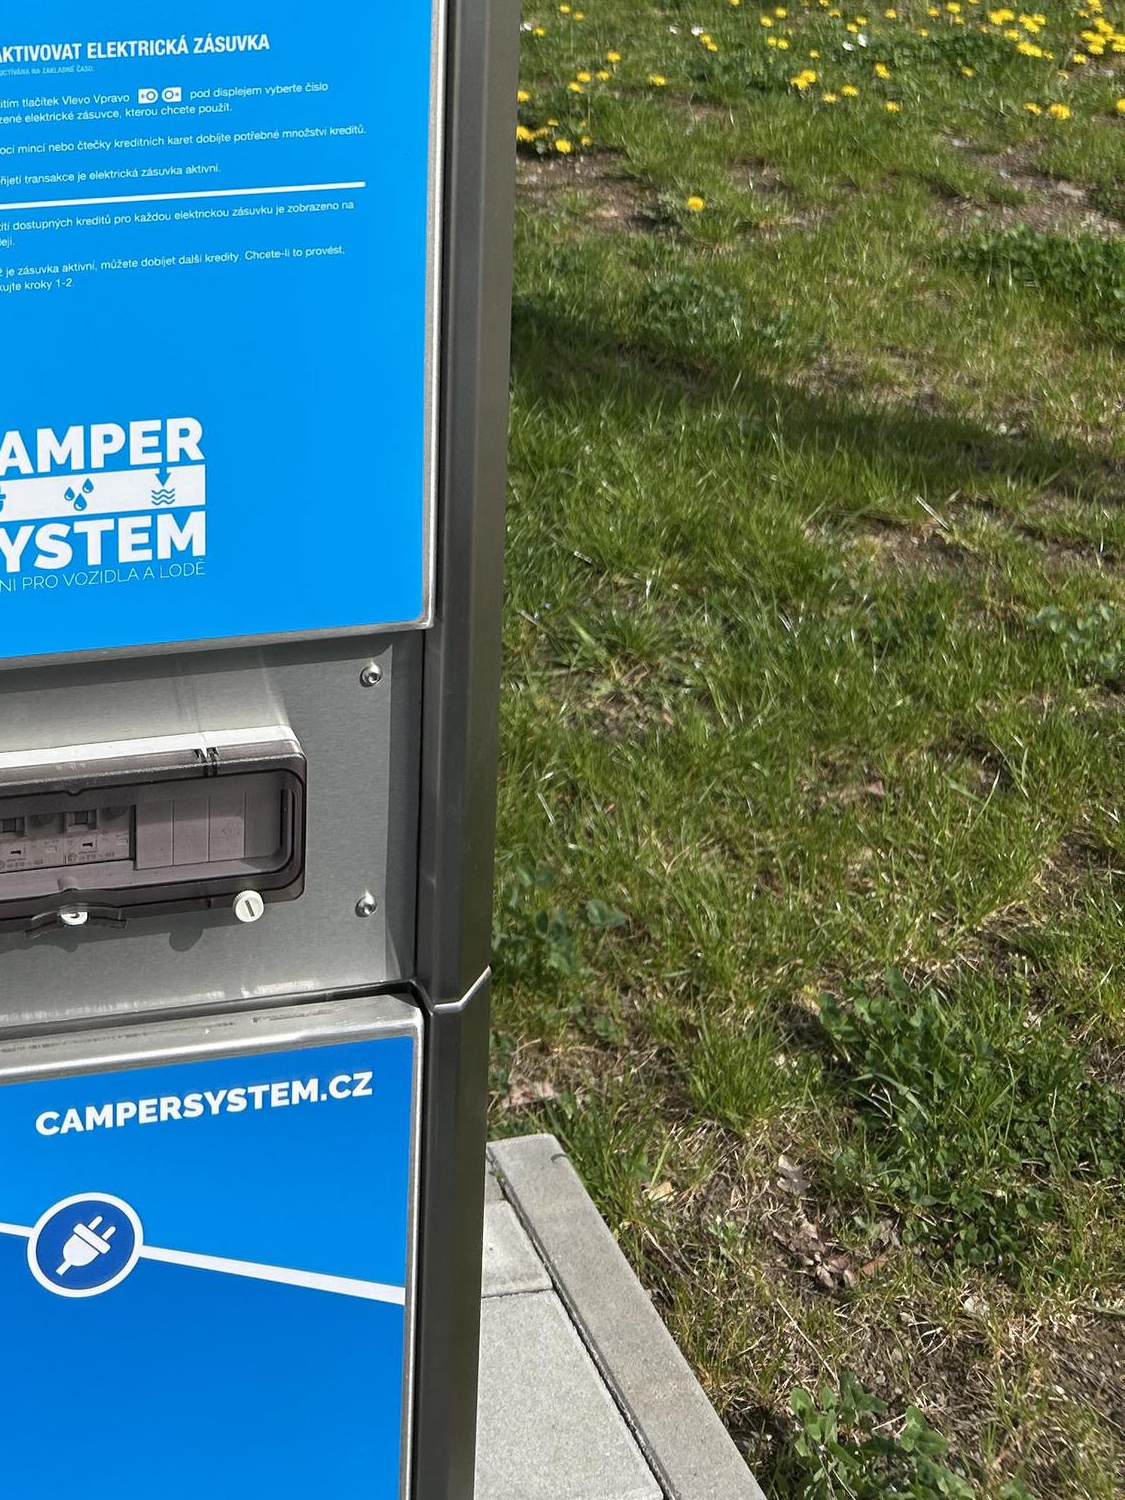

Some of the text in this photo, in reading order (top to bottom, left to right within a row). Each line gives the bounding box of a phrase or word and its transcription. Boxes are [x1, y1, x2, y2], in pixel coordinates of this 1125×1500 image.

[87, 34, 189, 60] ELEKTRICKÁ
[193, 33, 270, 54] ZÁSUVKA
[22, 94, 59, 108] tlačítek
[62, 94, 91, 106] Vlevo
[93, 93, 130, 107] Vpravo
[190, 88, 210, 100] pod
[213, 85, 262, 99] displejem
[264, 83, 302, 96] vyberte
[305, 81, 329, 92] číslo
[24, 111, 74, 123] elektrické
[77, 109, 122, 120] zásuvce,
[125, 106, 157, 117] kterou
[161, 104, 196, 115] chcete
[198, 102, 233, 116] použít.
[18, 143, 46, 154] mincí
[48, 142, 75, 152] nebo
[77, 139, 111, 152] čtečky
[114, 136, 164, 148] kreditních
[167, 134, 193, 145] karet
[195, 132, 231, 145] dobíjte
[233, 130, 279, 143] potřebné
[330, 123, 367, 136] kreditů.
[24, 173, 75, 184] transakce
[77, 172, 86, 183] je
[89, 169, 138, 180] elektrická
[141, 166, 183, 177] zásuvka
[185, 163, 221, 174] aktivní.
[13, 217, 73, 231] dostupných
[76, 214, 111, 226] kreditů
[114, 215, 131, 225] pro
[134, 211, 172, 223] každou
[174, 207, 229, 220] elektrickou
[232, 205, 273, 217] zásuvku
[276, 204, 285, 215] je
[287, 202, 339, 213] zobrazeno
[342, 201, 355, 210] na
[5, 267, 15, 278] je
[18, 264, 59, 276] zásuvka
[101, 257, 139, 269] můžete
[141, 256, 176, 269] dobíjet
[178, 253, 203, 265] další
[245, 249, 290, 260] Chcete-li
[293, 247, 303, 257] to
[24, 280, 52, 292] kroky
[22, 573, 59, 591] PRO
[63, 567, 139, 587] VOZIDLA
[143, 566, 155, 579] A
[160, 558, 206, 579] LODĚ
[35, 1071, 374, 1136] CAMPERSYSTEM.CZ
